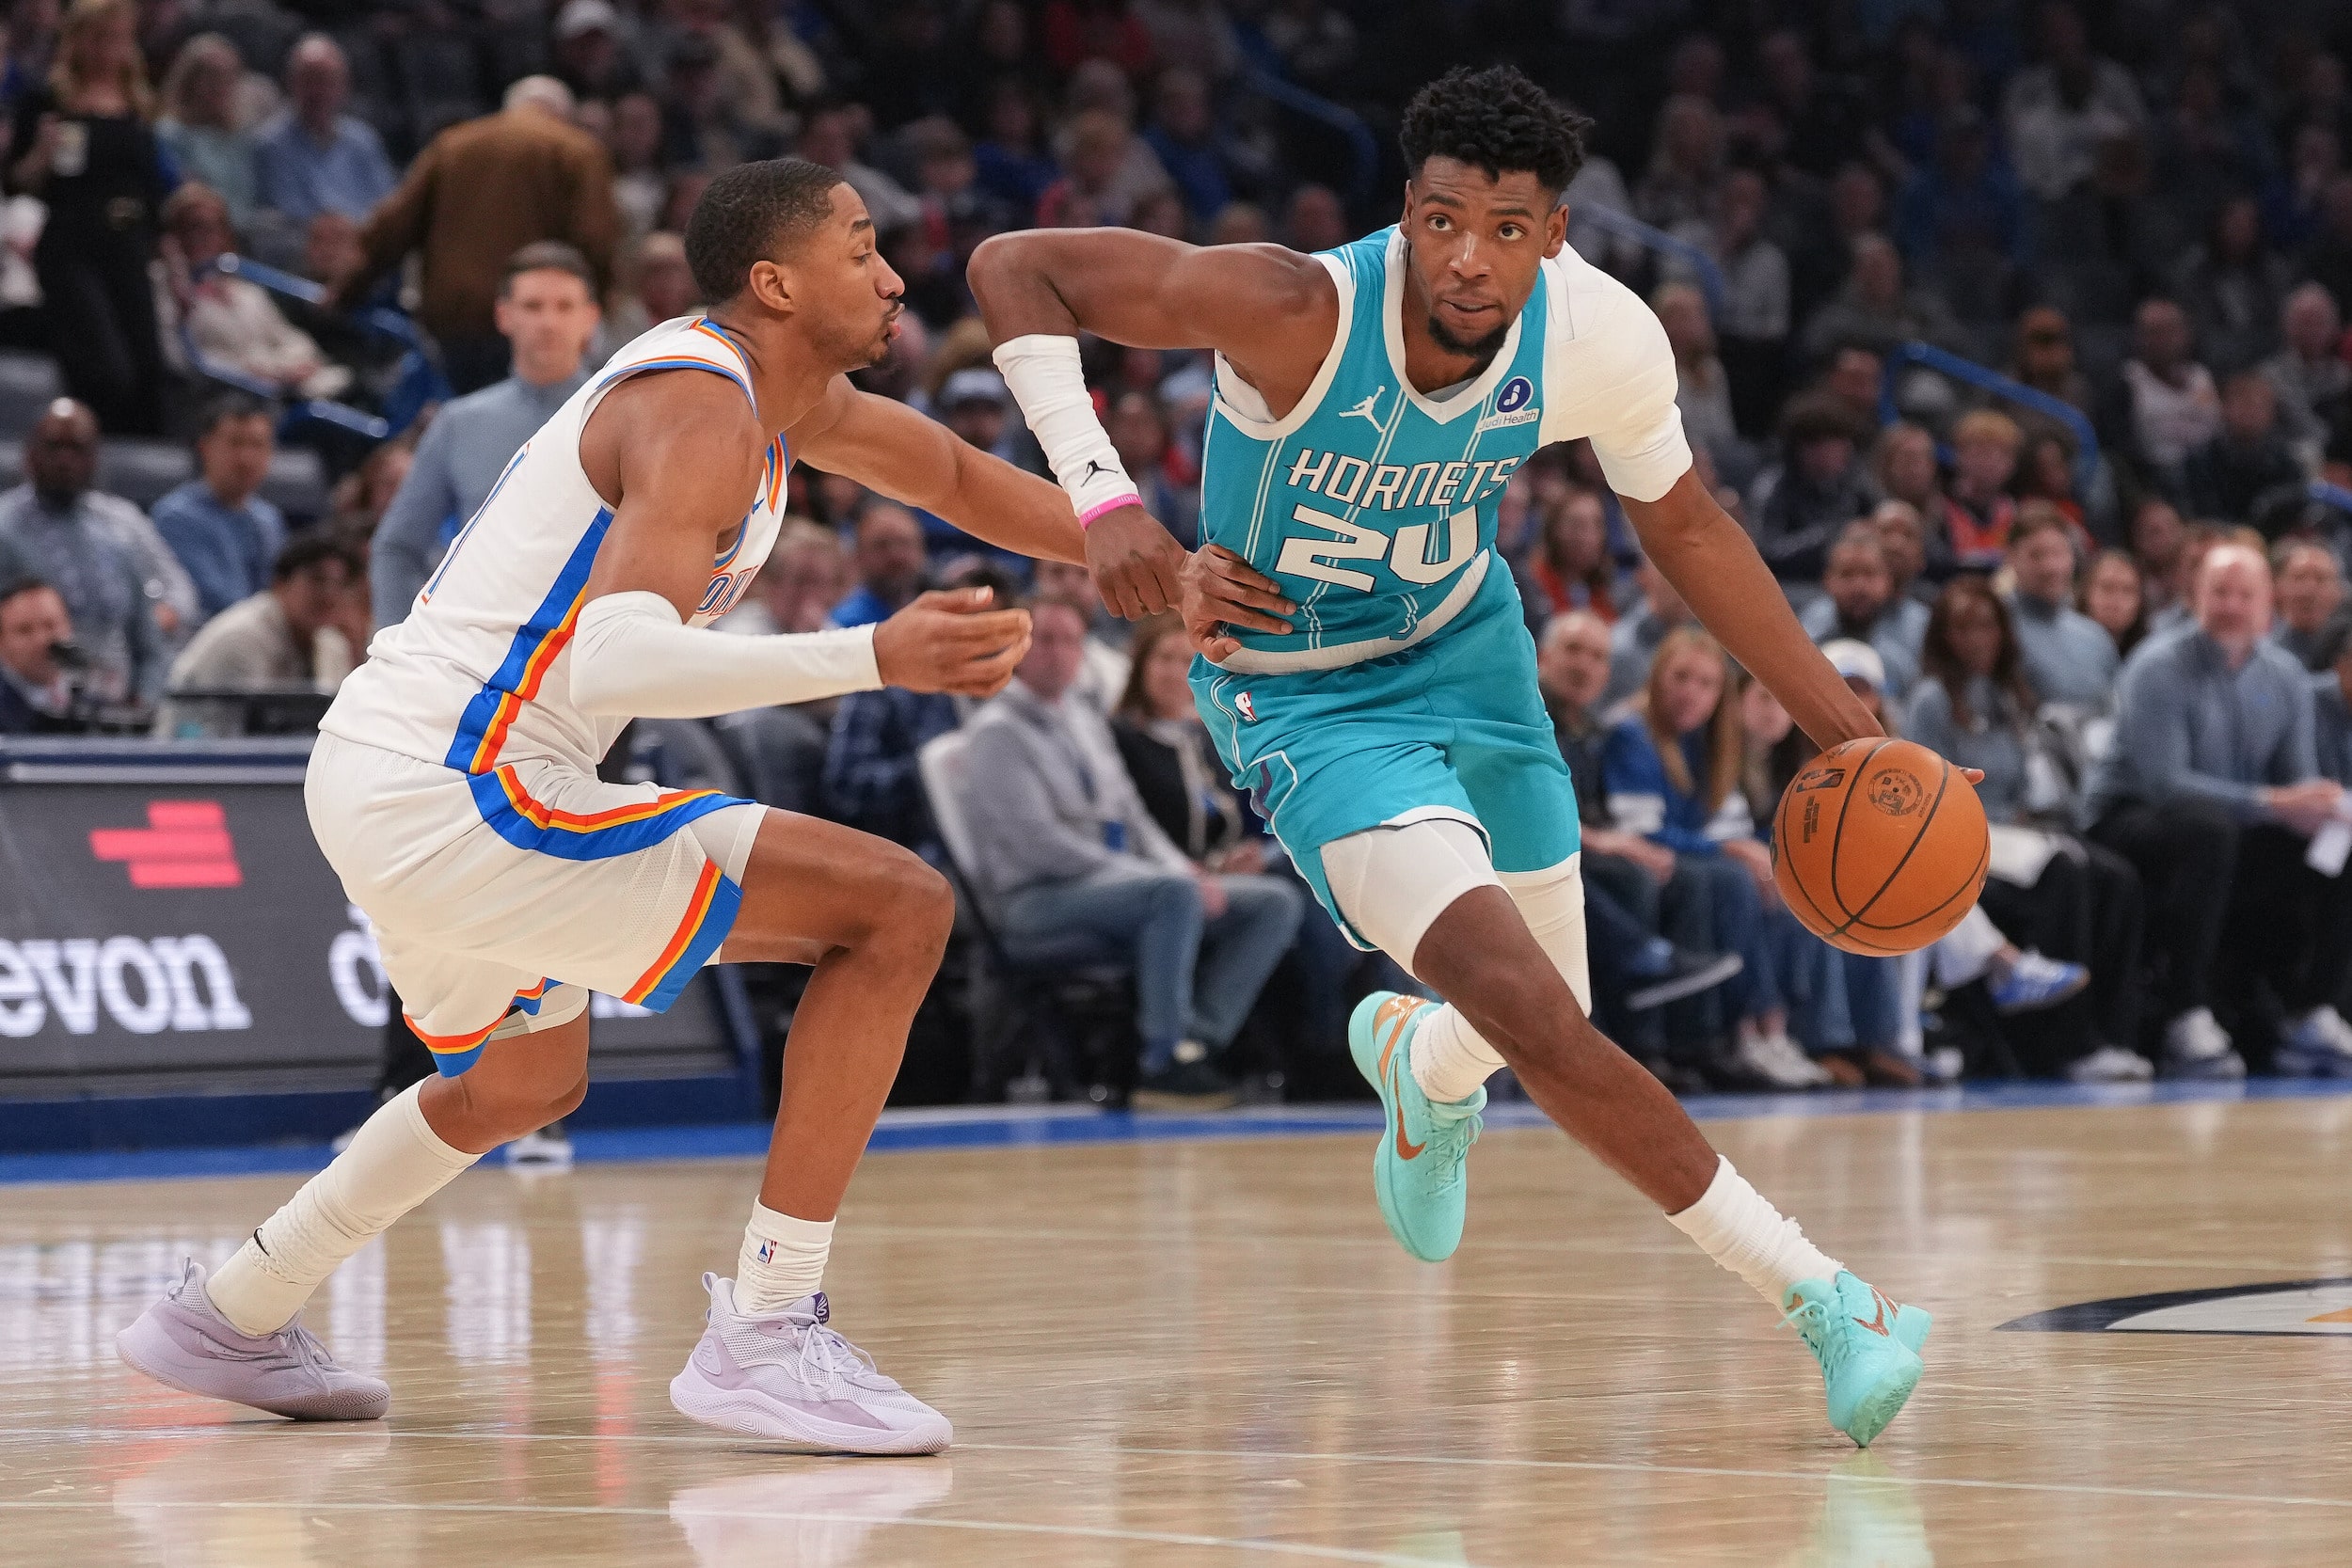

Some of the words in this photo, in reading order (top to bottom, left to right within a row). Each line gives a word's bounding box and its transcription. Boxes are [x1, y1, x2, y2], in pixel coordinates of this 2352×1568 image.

[1479, 416, 1502, 431] Judi
[1503, 410, 1536, 425] Health
[1286, 448, 1521, 511] HORNETS
[1274, 503, 1479, 594] 20
[0, 934, 253, 1037] evon
